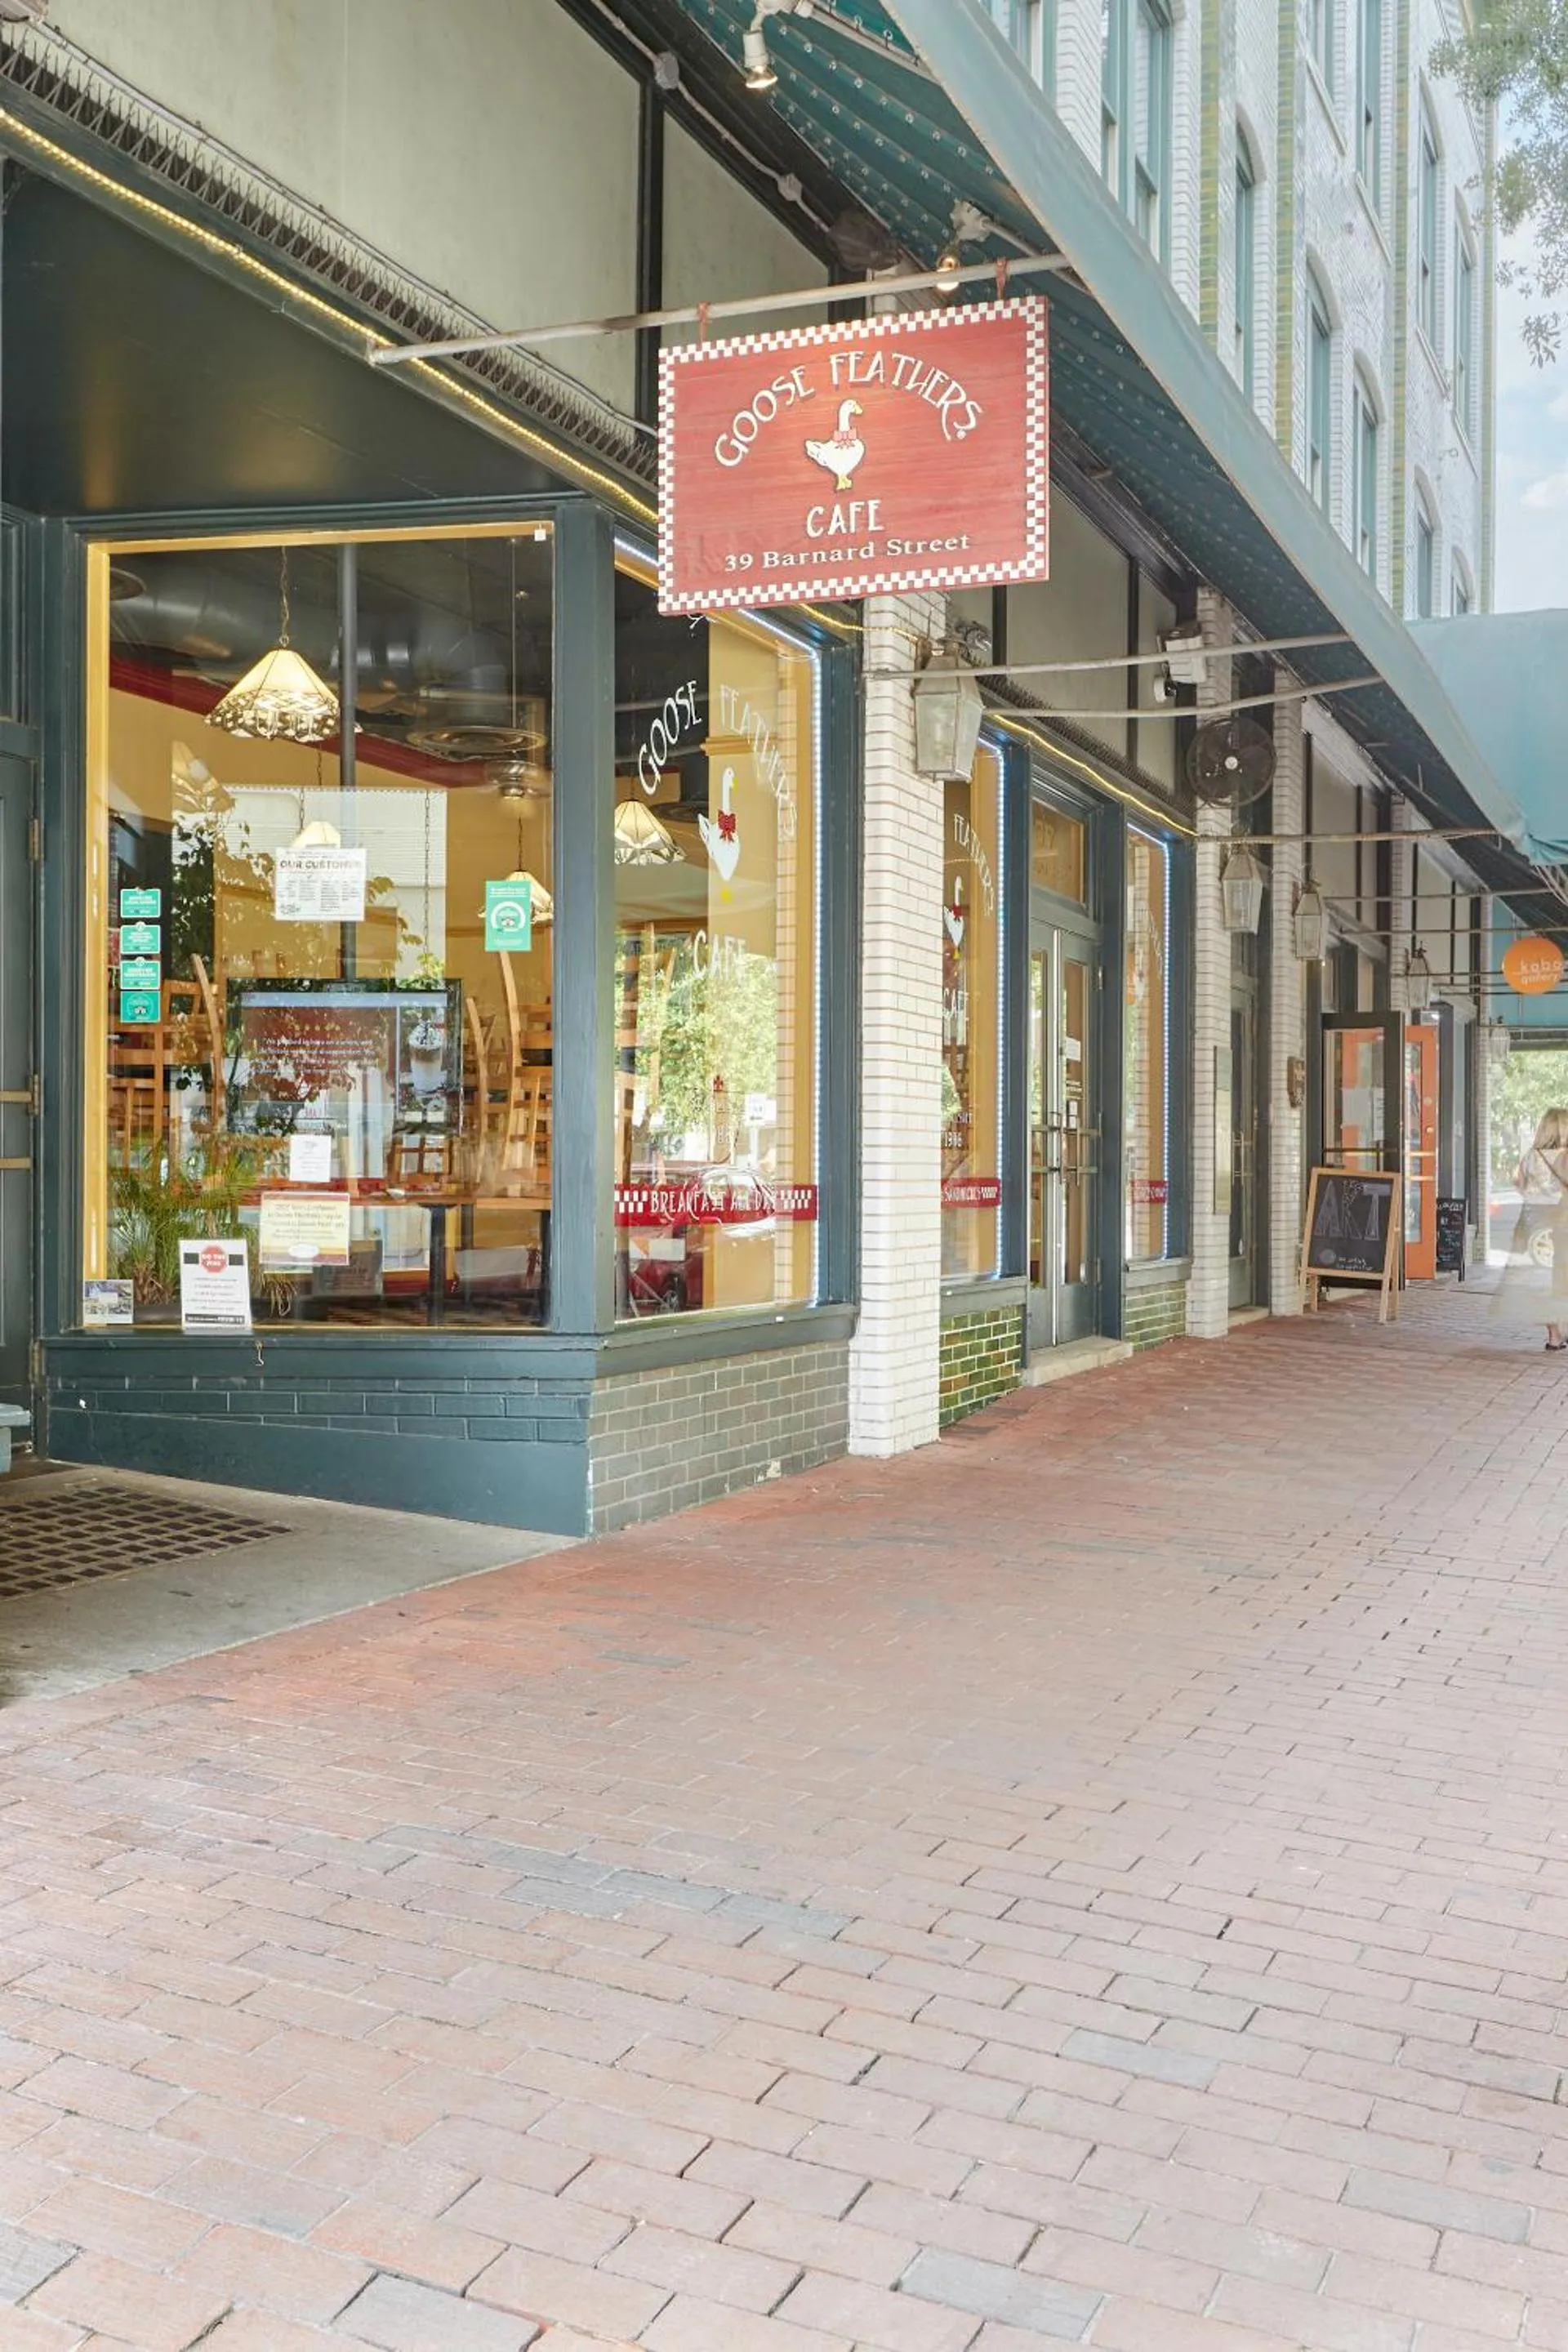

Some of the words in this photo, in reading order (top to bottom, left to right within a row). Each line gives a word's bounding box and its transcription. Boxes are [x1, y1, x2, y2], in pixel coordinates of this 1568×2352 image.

[714, 365, 815, 467] GOOSE
[829, 350, 983, 441] FEATHERS
[805, 499, 885, 537] CAFE
[724, 554, 753, 572] 39
[762, 541, 875, 568] Barnard
[886, 534, 970, 556] Street
[638, 679, 702, 795] GOOSE
[650, 1191, 726, 1218] BREAKFAST
